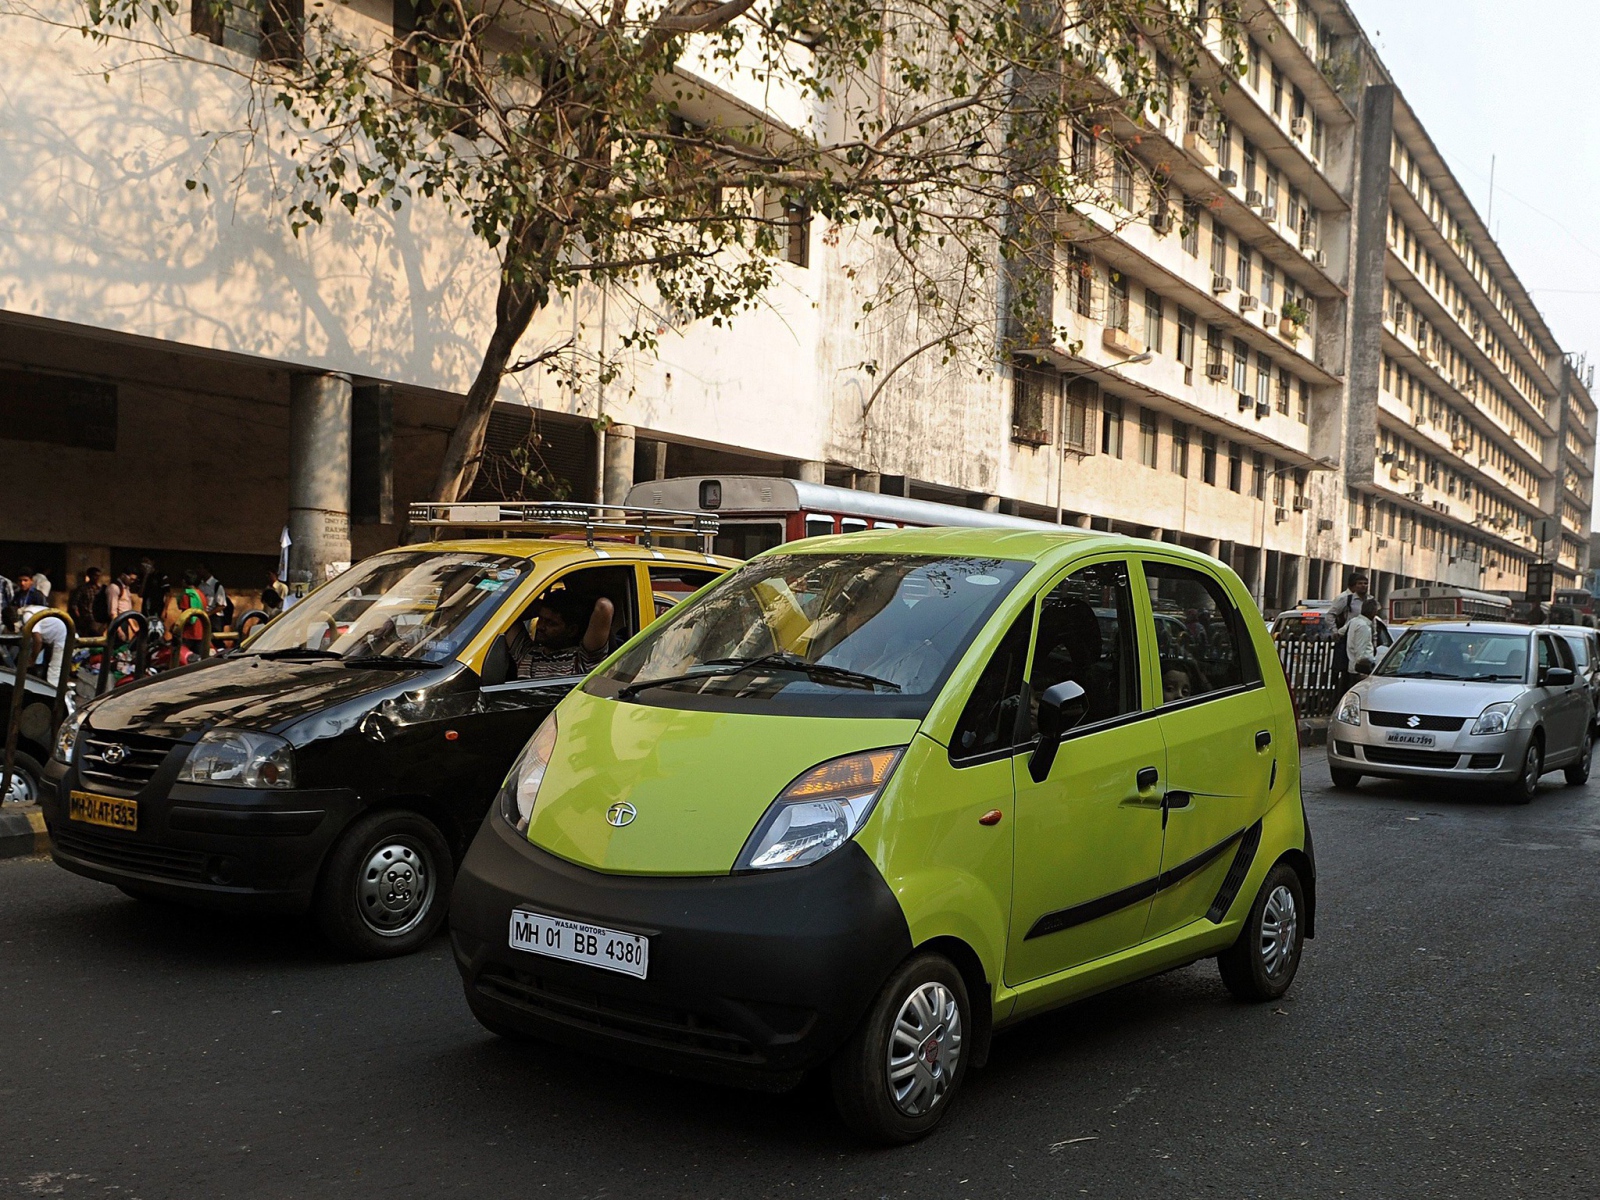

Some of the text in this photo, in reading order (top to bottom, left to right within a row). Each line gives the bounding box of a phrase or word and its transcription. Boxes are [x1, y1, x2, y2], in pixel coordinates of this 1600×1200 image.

[554, 920, 606, 936] WASAN MOTORS
[515, 921, 641, 966] MH 01 BB 4380
